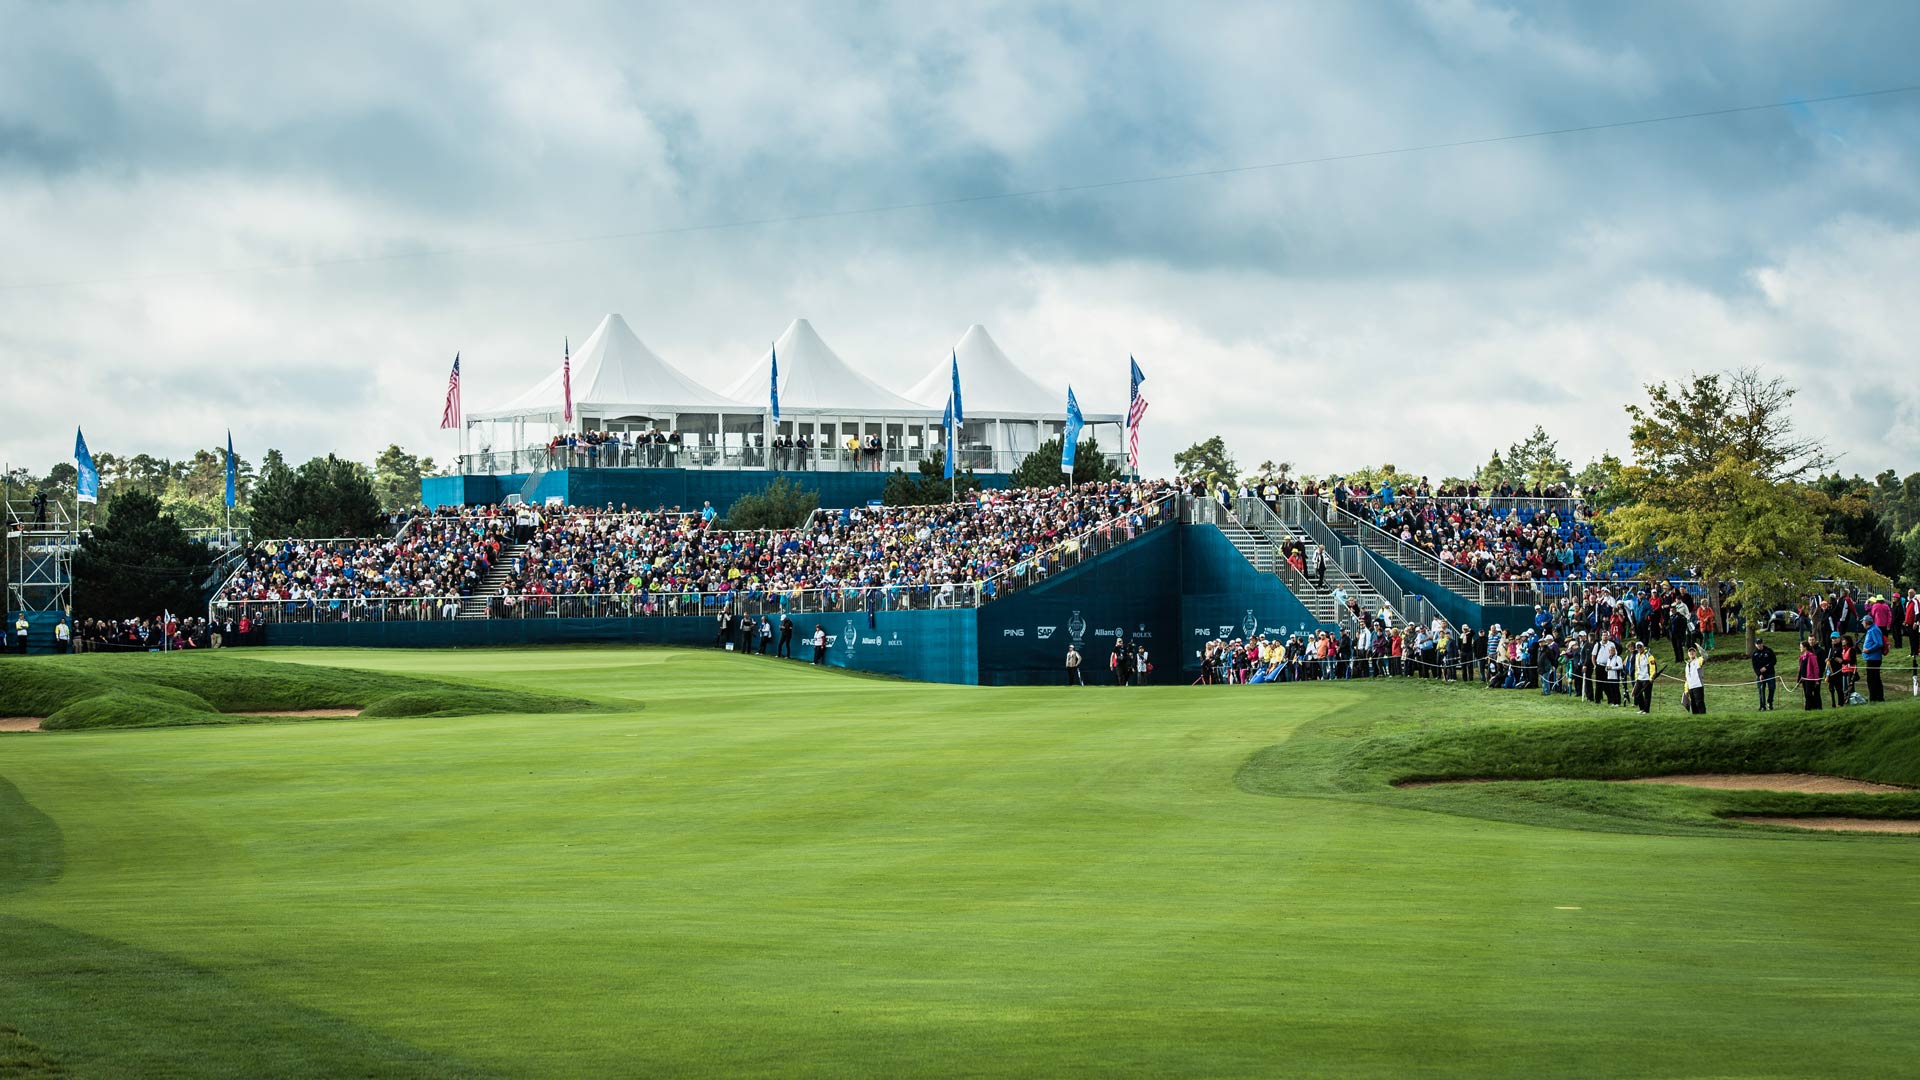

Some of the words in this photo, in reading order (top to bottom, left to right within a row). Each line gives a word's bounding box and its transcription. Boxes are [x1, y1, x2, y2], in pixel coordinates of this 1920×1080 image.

[1004, 628, 1024, 636] PING
[1038, 628, 1053, 637] SAP
[1220, 627, 1232, 636] SAP
